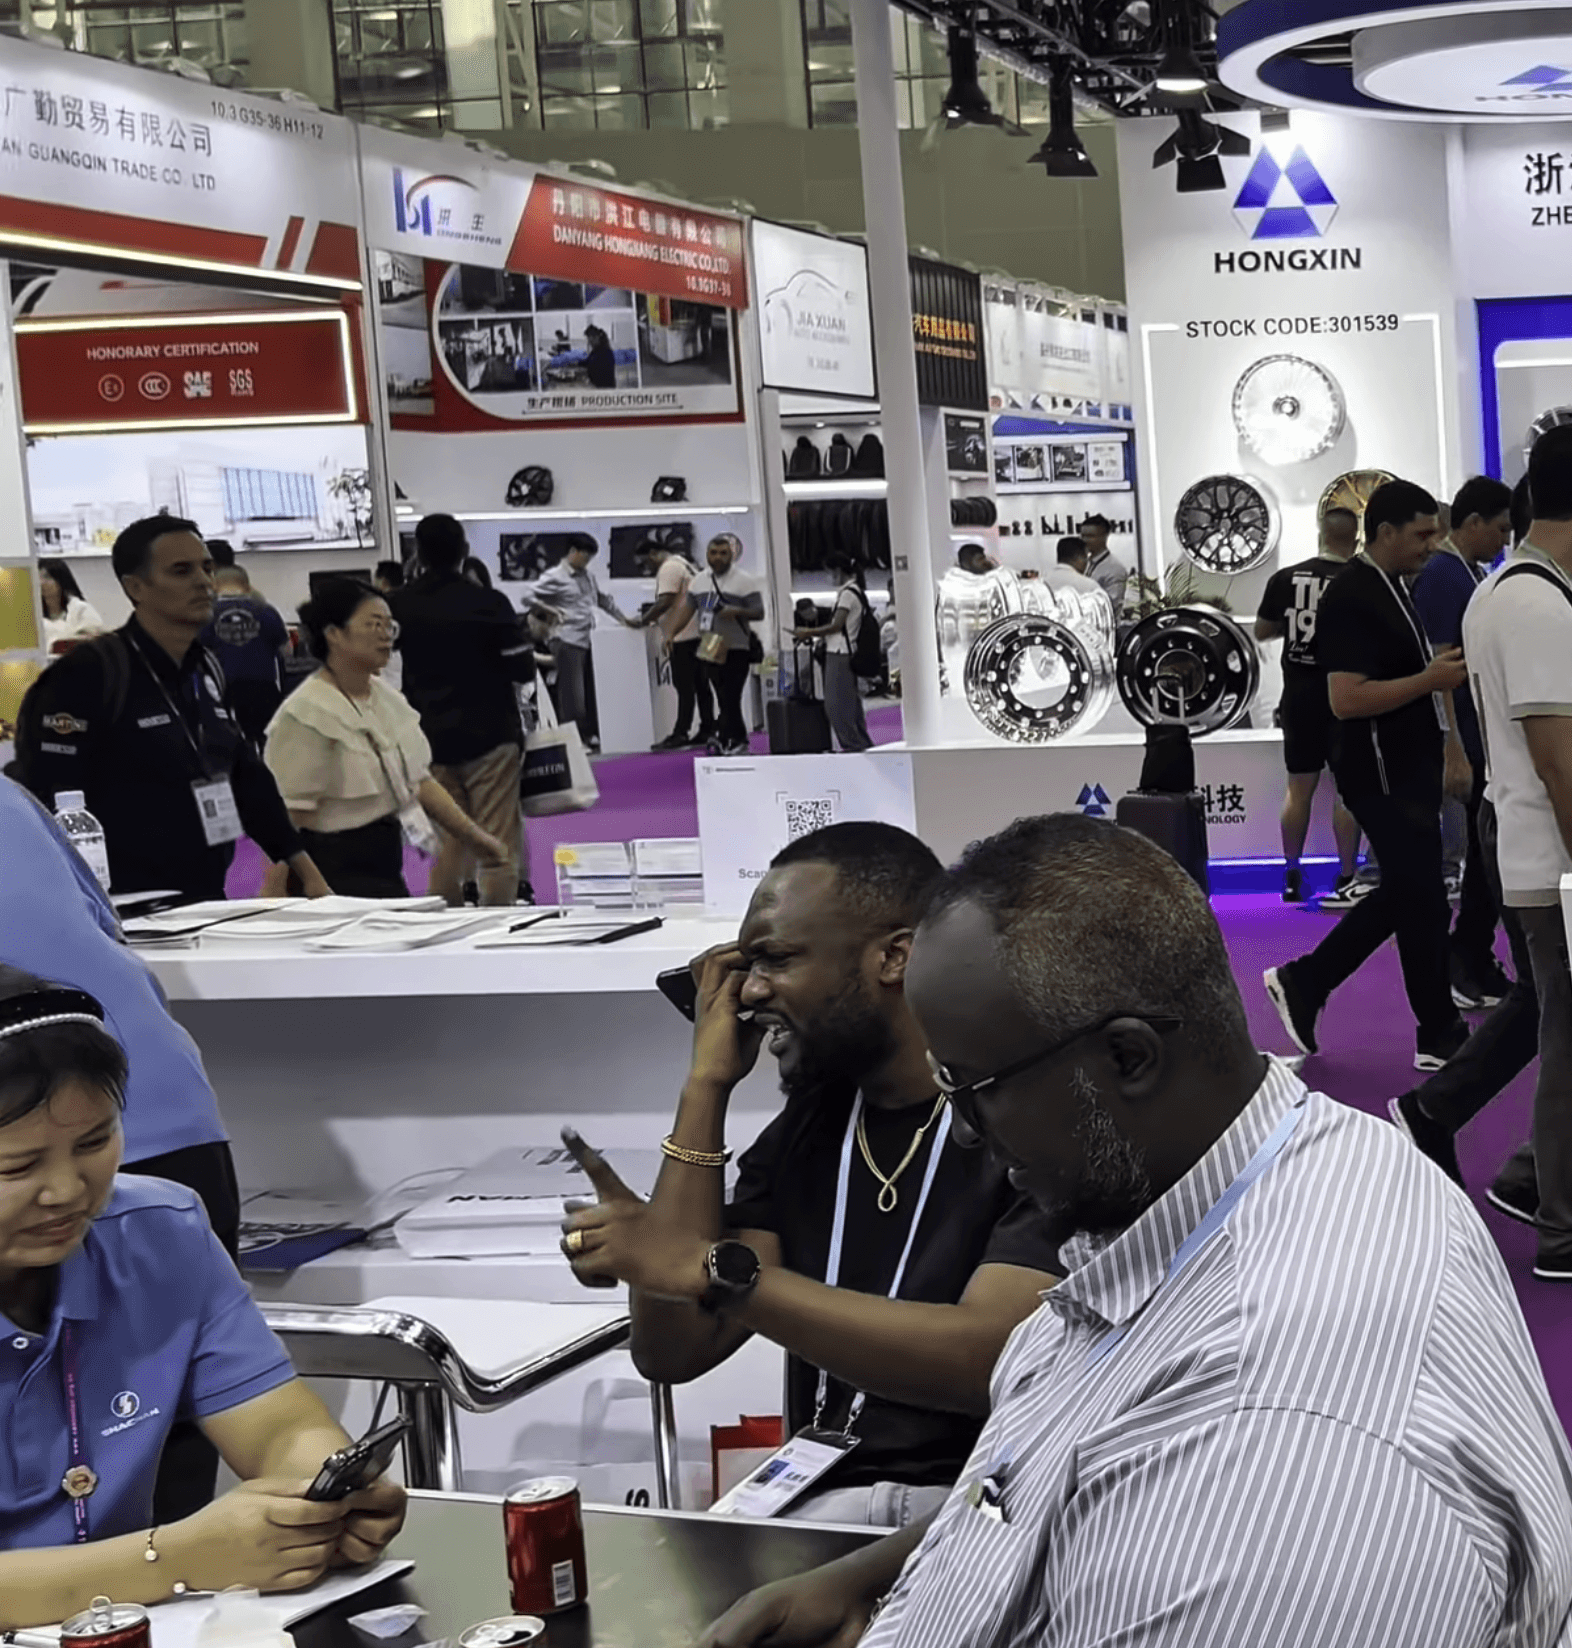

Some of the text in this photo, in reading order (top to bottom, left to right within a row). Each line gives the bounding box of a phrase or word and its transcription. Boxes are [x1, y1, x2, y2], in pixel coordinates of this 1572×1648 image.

[29, 143, 108, 173] GUANGQIN
[111, 157, 158, 182] TRADE
[192, 172, 216, 192] LTD
[553, 226, 603, 251] DANYANG
[1213, 247, 1363, 274] HONGXIN
[815, 312, 846, 332] XUAN
[1185, 313, 1400, 339] STOCK CODE:301539
[87, 341, 260, 360] HONORARY CERTIFICATION
[228, 368, 254, 391] SGS
[580, 392, 677, 407] PRODUCTION SITE
[1284, 607, 1317, 644] 19
[1205, 814, 1247, 825] NOLOGY
